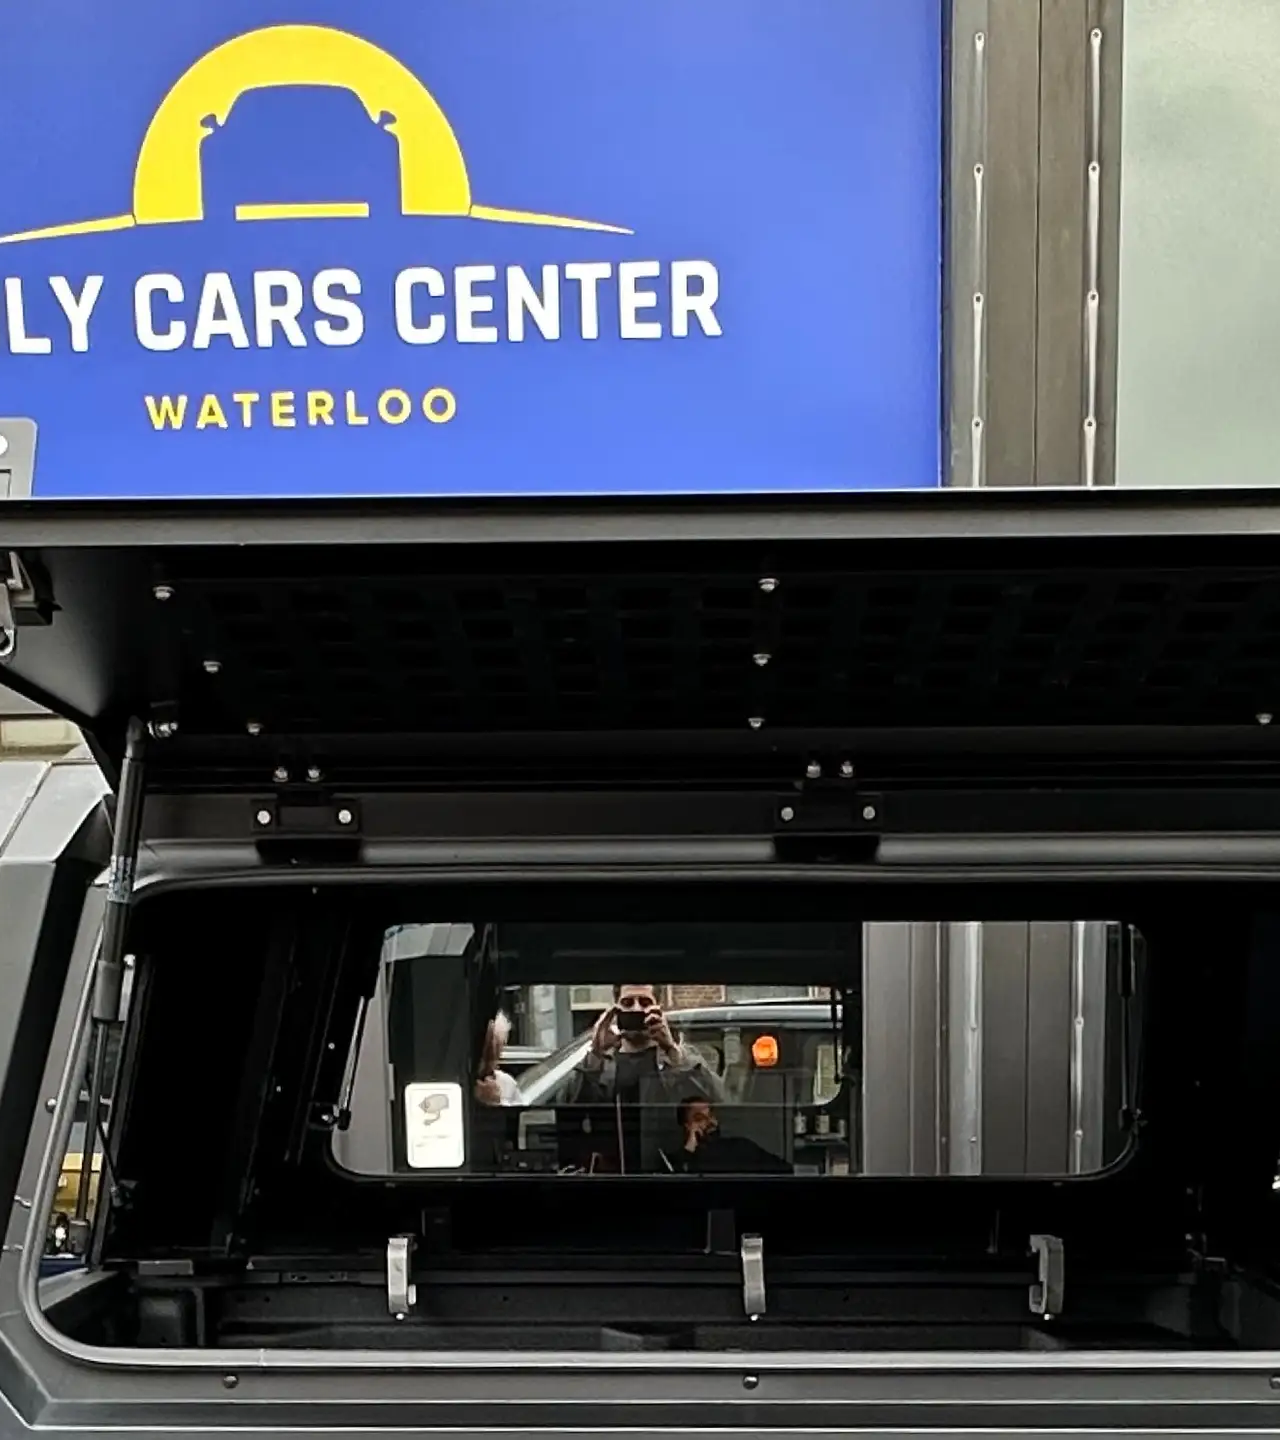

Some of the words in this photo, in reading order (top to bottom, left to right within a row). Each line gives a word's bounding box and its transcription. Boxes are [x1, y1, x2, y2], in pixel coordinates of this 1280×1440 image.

[133, 267, 365, 351] CARS
[394, 259, 723, 345] CENTER
[143, 386, 457, 431] WATERLOO
